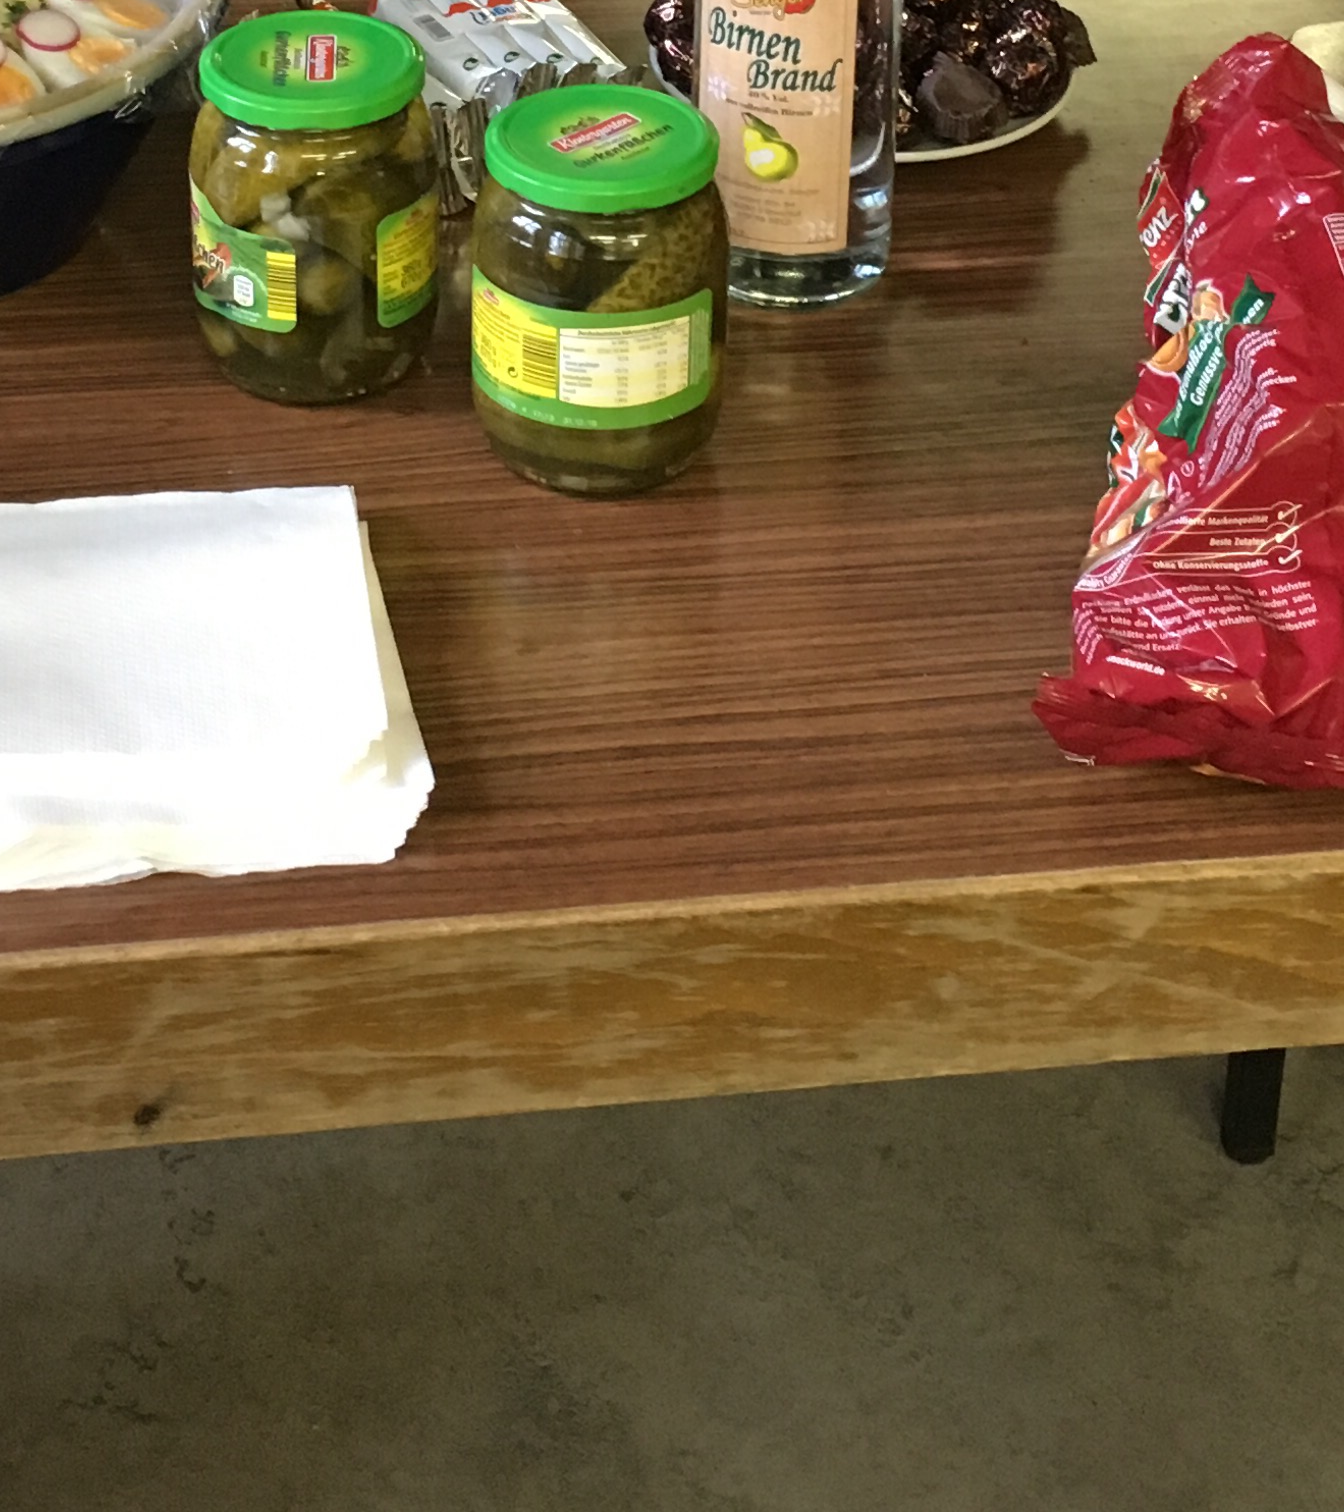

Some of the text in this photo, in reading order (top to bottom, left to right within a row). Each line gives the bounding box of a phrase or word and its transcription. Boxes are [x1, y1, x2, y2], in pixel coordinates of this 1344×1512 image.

[708, 7, 802, 65] Birnen
[746, 58, 844, 93] Brand
[1209, 537, 1233, 546] Beste
[1152, 560, 1176, 569] Ohne
